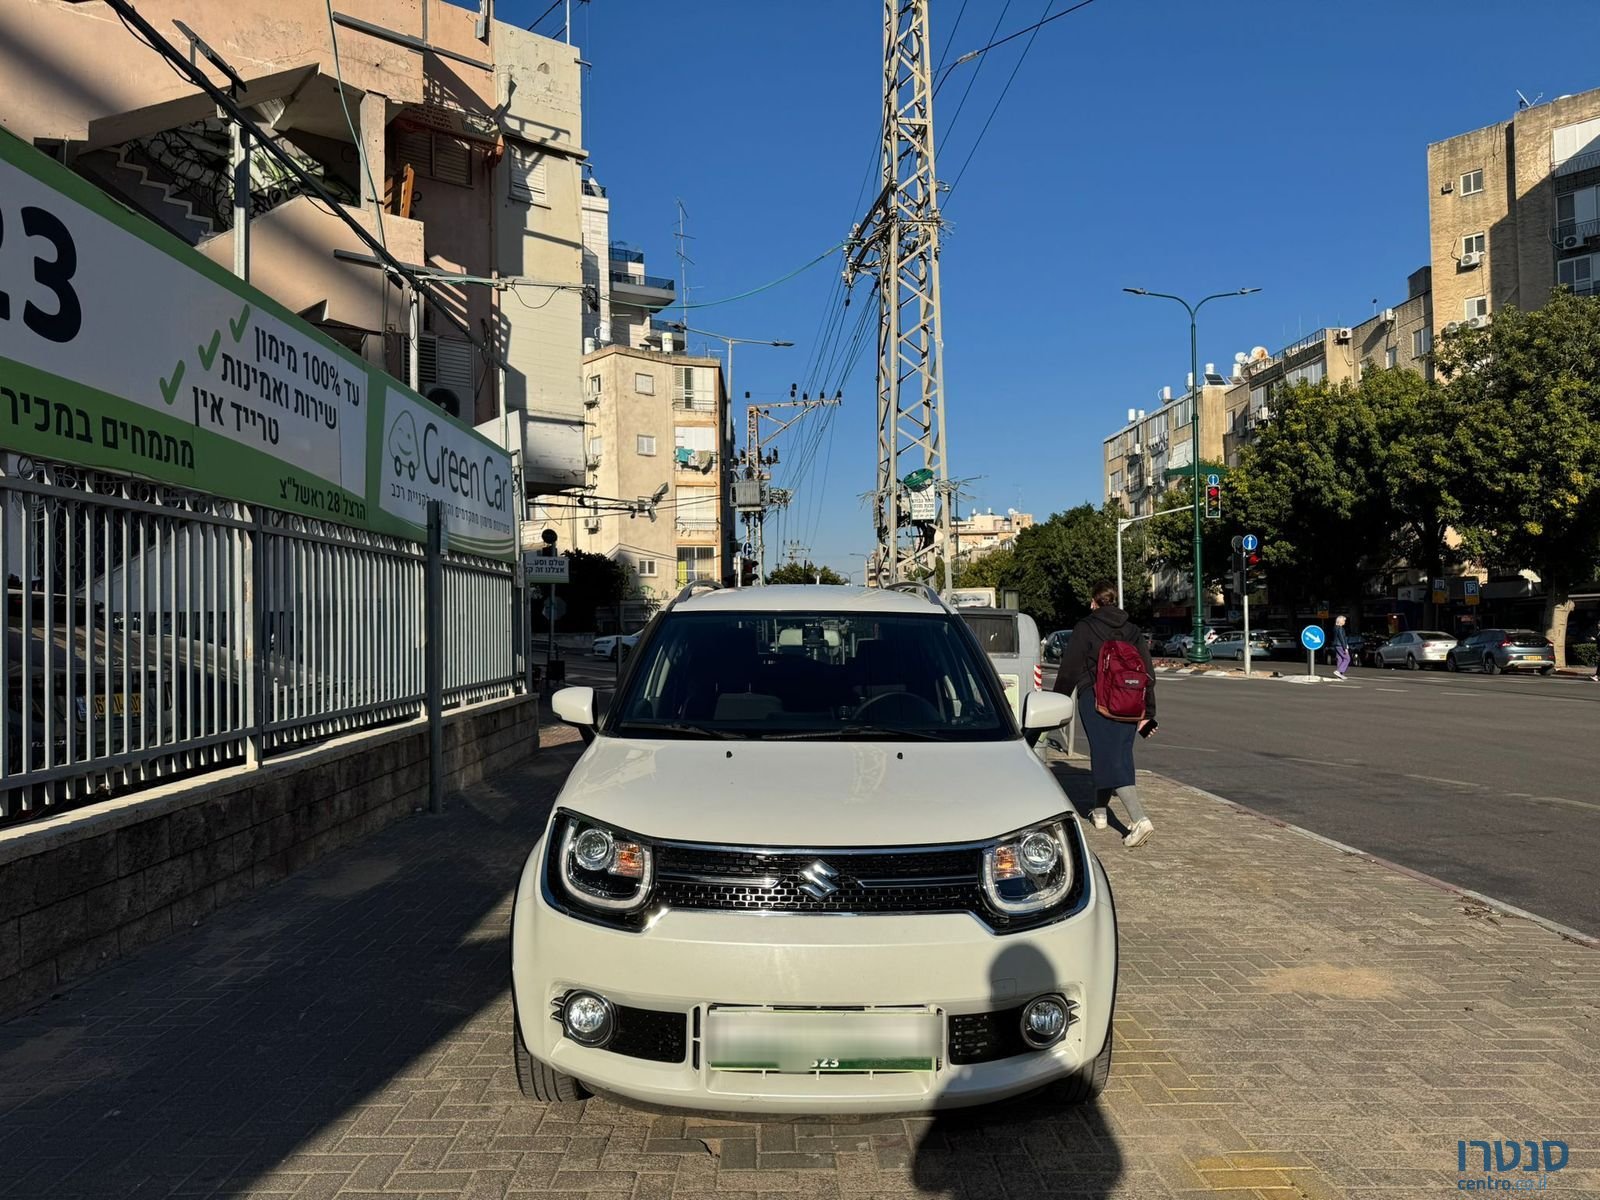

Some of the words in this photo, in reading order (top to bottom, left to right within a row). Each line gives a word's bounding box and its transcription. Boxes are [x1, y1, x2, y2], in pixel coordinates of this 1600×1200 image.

[0, 206, 82, 343] 3
[254, 326, 298, 374] מימון
[221, 353, 289, 410] ואמינות
[303, 352, 341, 397] 100%
[343, 378, 360, 406] עד
[192, 386, 225, 427] אין
[230, 401, 280, 445] טרייד
[294, 388, 337, 430] שירות
[101, 416, 195, 469] מתמחים
[423, 422, 480, 502] Green
[483, 456, 508, 512] Car
[327, 490, 340, 513] 28
[343, 494, 366, 520] הרצל
[391, 483, 406, 500] רכב
